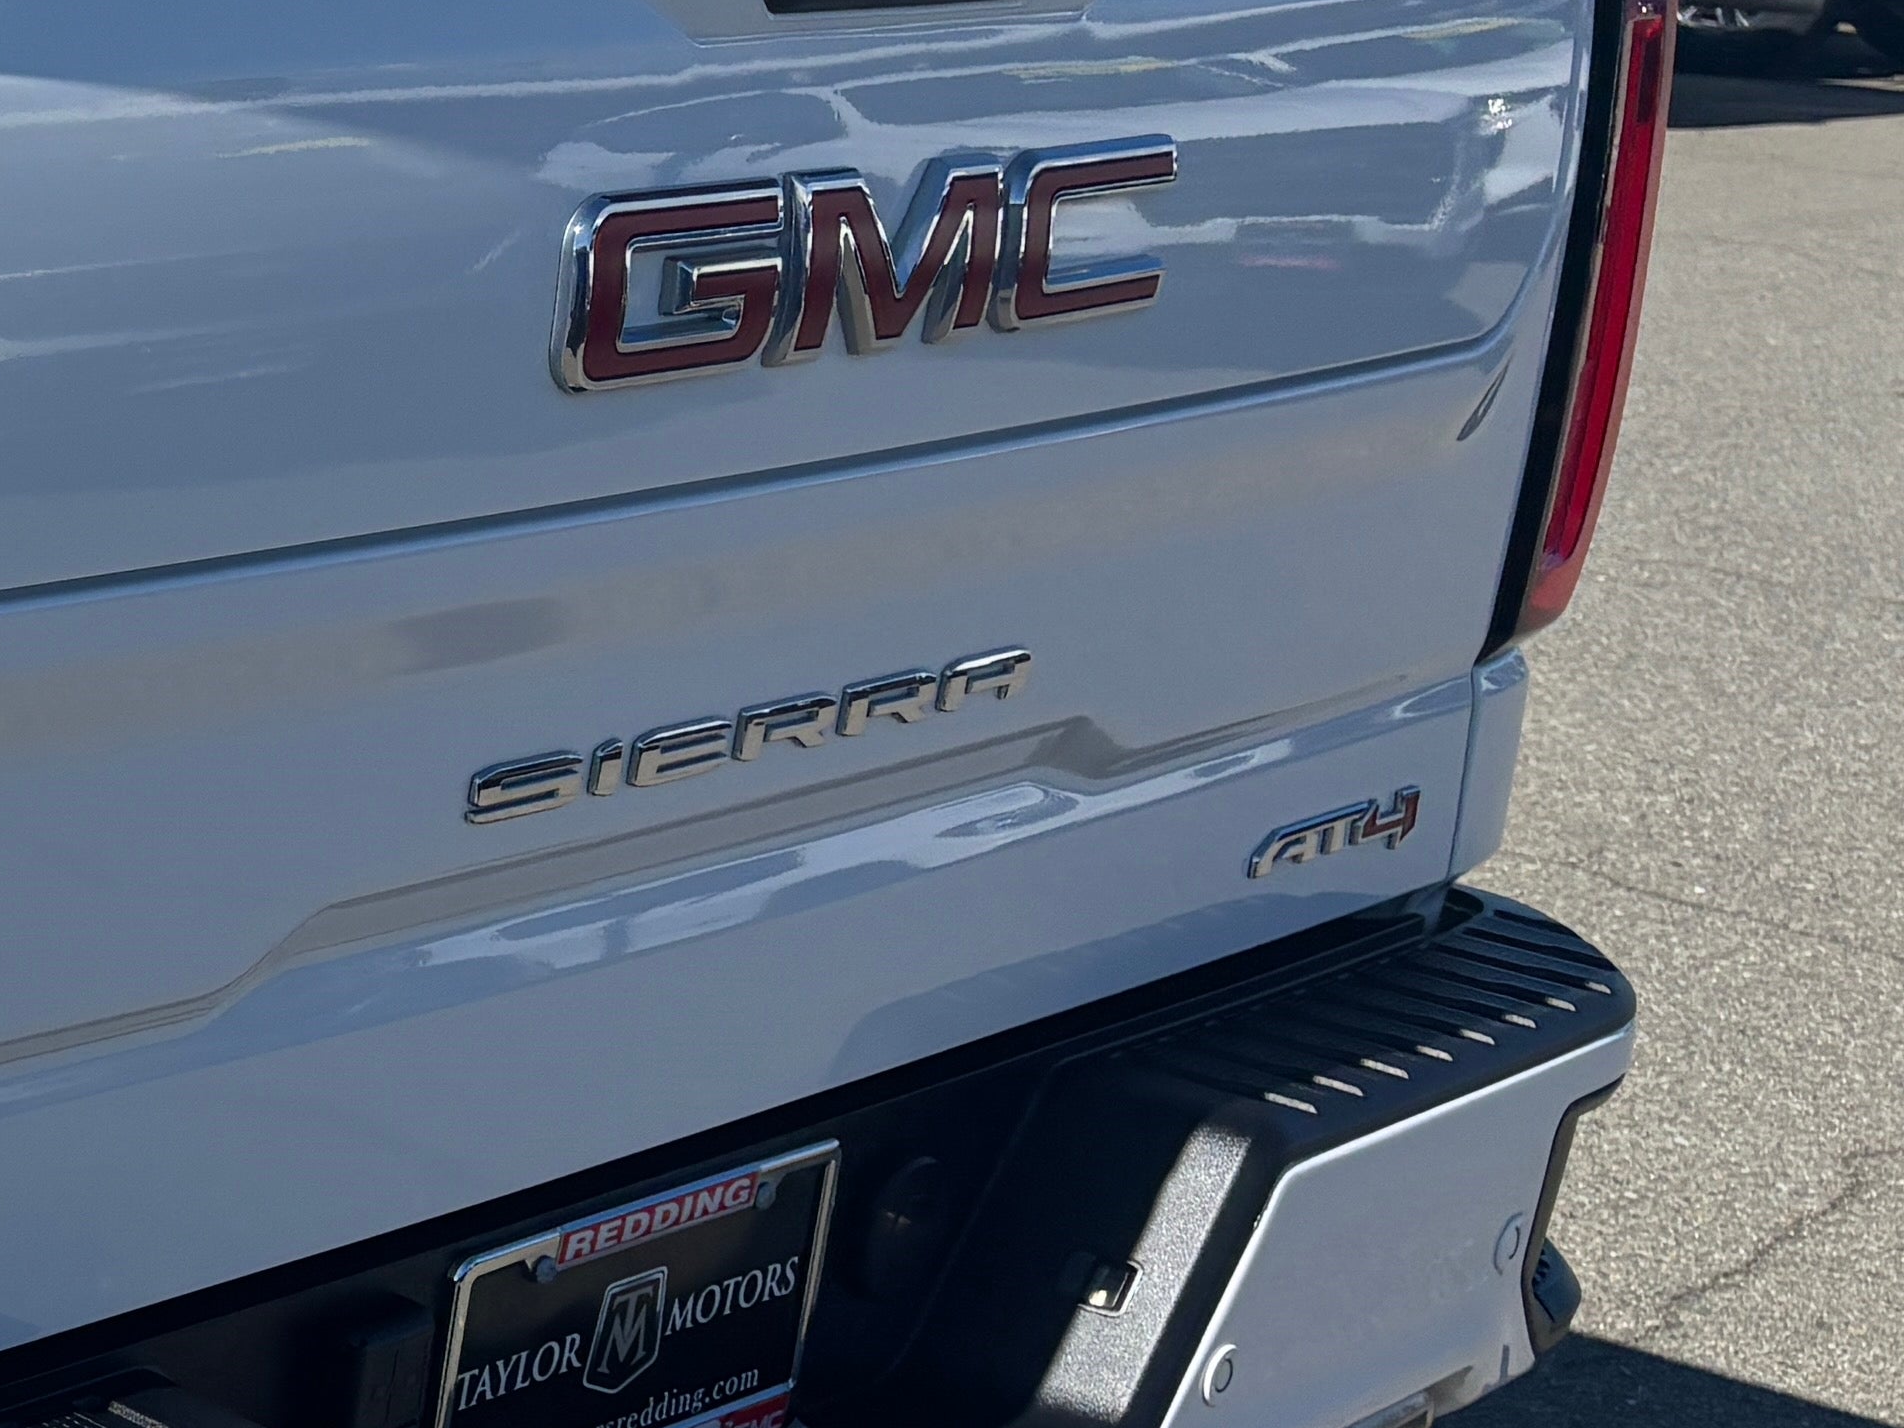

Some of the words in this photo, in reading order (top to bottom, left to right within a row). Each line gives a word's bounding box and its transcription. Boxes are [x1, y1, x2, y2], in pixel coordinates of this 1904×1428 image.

[549, 132, 1178, 393] GMC
[464, 645, 1033, 824] SIERRA
[1246, 784, 1421, 879] AT4
[564, 1176, 756, 1263] REDDING
[456, 1332, 583, 1411] TAYLOR
[664, 1255, 799, 1336] MOTORS
